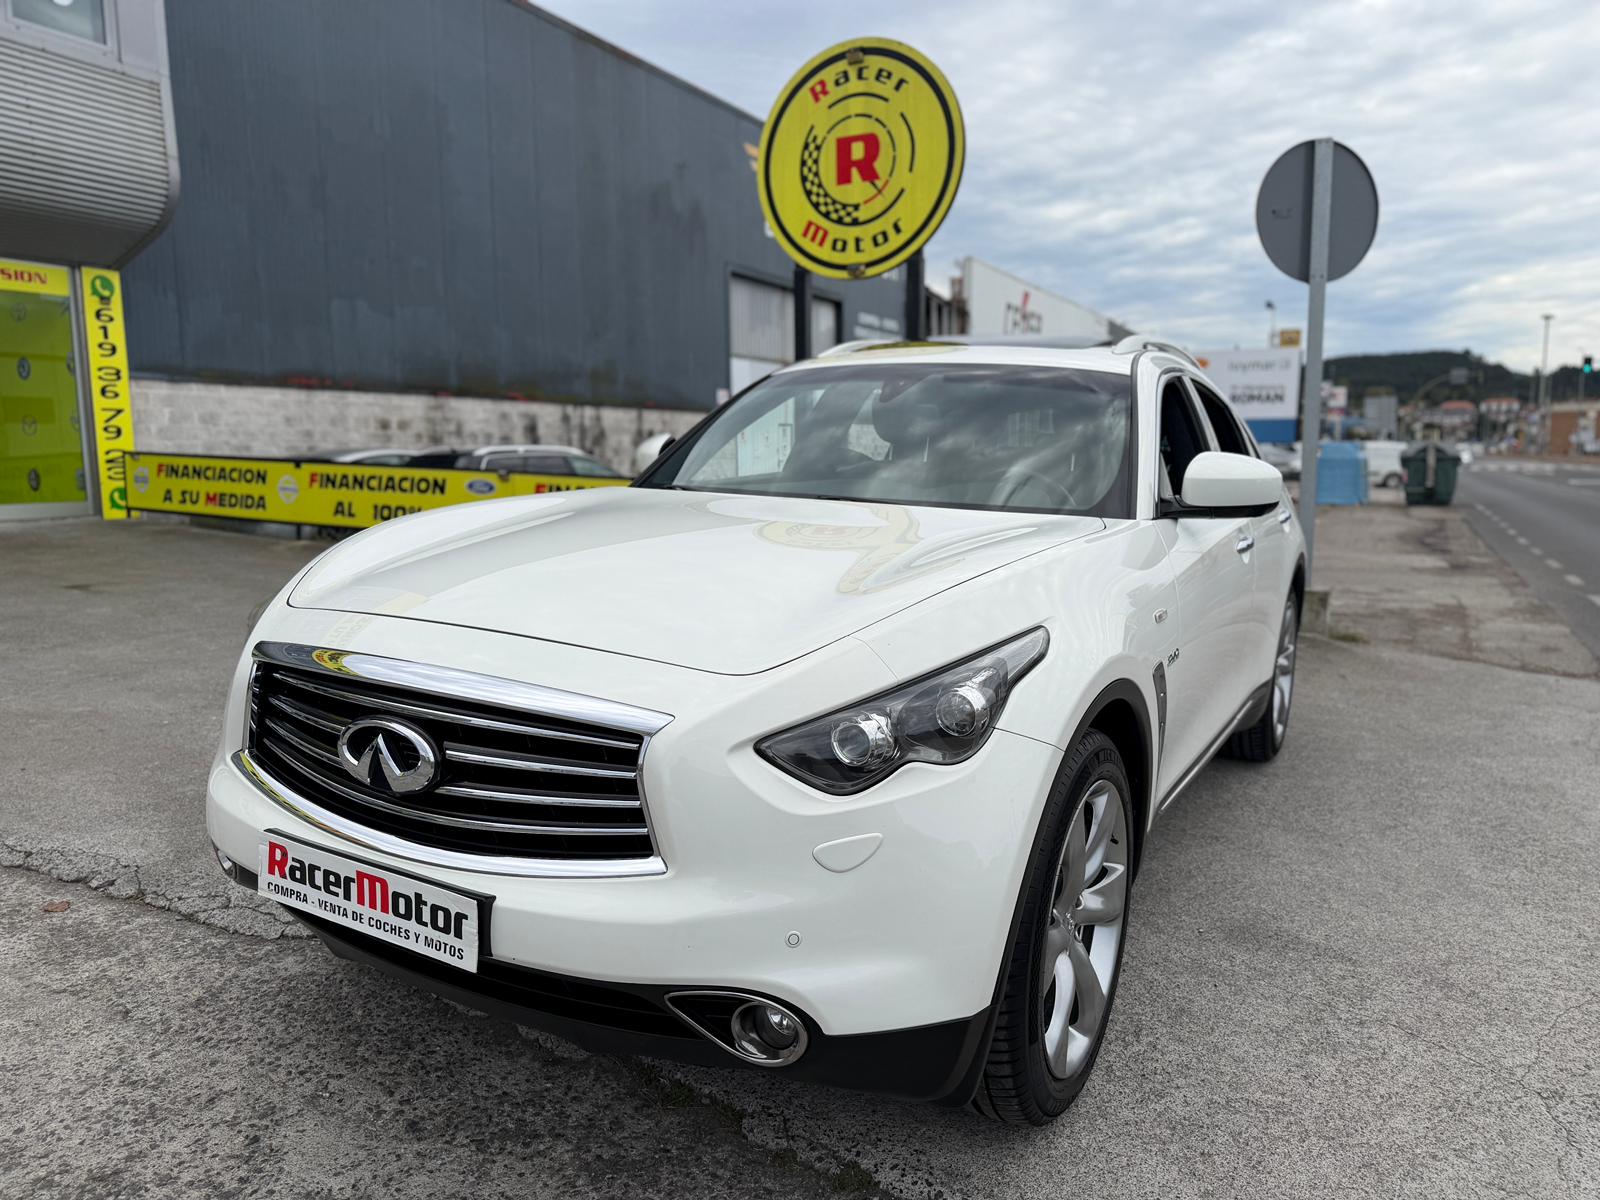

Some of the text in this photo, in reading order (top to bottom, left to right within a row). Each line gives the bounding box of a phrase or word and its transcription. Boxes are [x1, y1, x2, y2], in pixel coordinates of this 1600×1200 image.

[809, 65, 909, 103] Racer
[836, 132, 881, 186] R
[802, 218, 903, 254] Motor
[95, 306, 117, 358] 619
[97, 366, 122, 400] 36
[101, 407, 125, 441] 79
[157, 463, 267, 485] FINANCIACION
[309, 471, 446, 495] FINANCIACION
[162, 488, 266, 510] A SU MEDIDA
[333, 501, 355, 518] AL
[267, 840, 468, 940] RacerMotor
[267, 881, 308, 905] COMPRA
[318, 898, 349, 918] VENTA
[352, 910, 365, 925] DE
[368, 916, 410, 940] COCHES
[414, 931, 421, 946] Y
[424, 937, 464, 960] MOTOS
